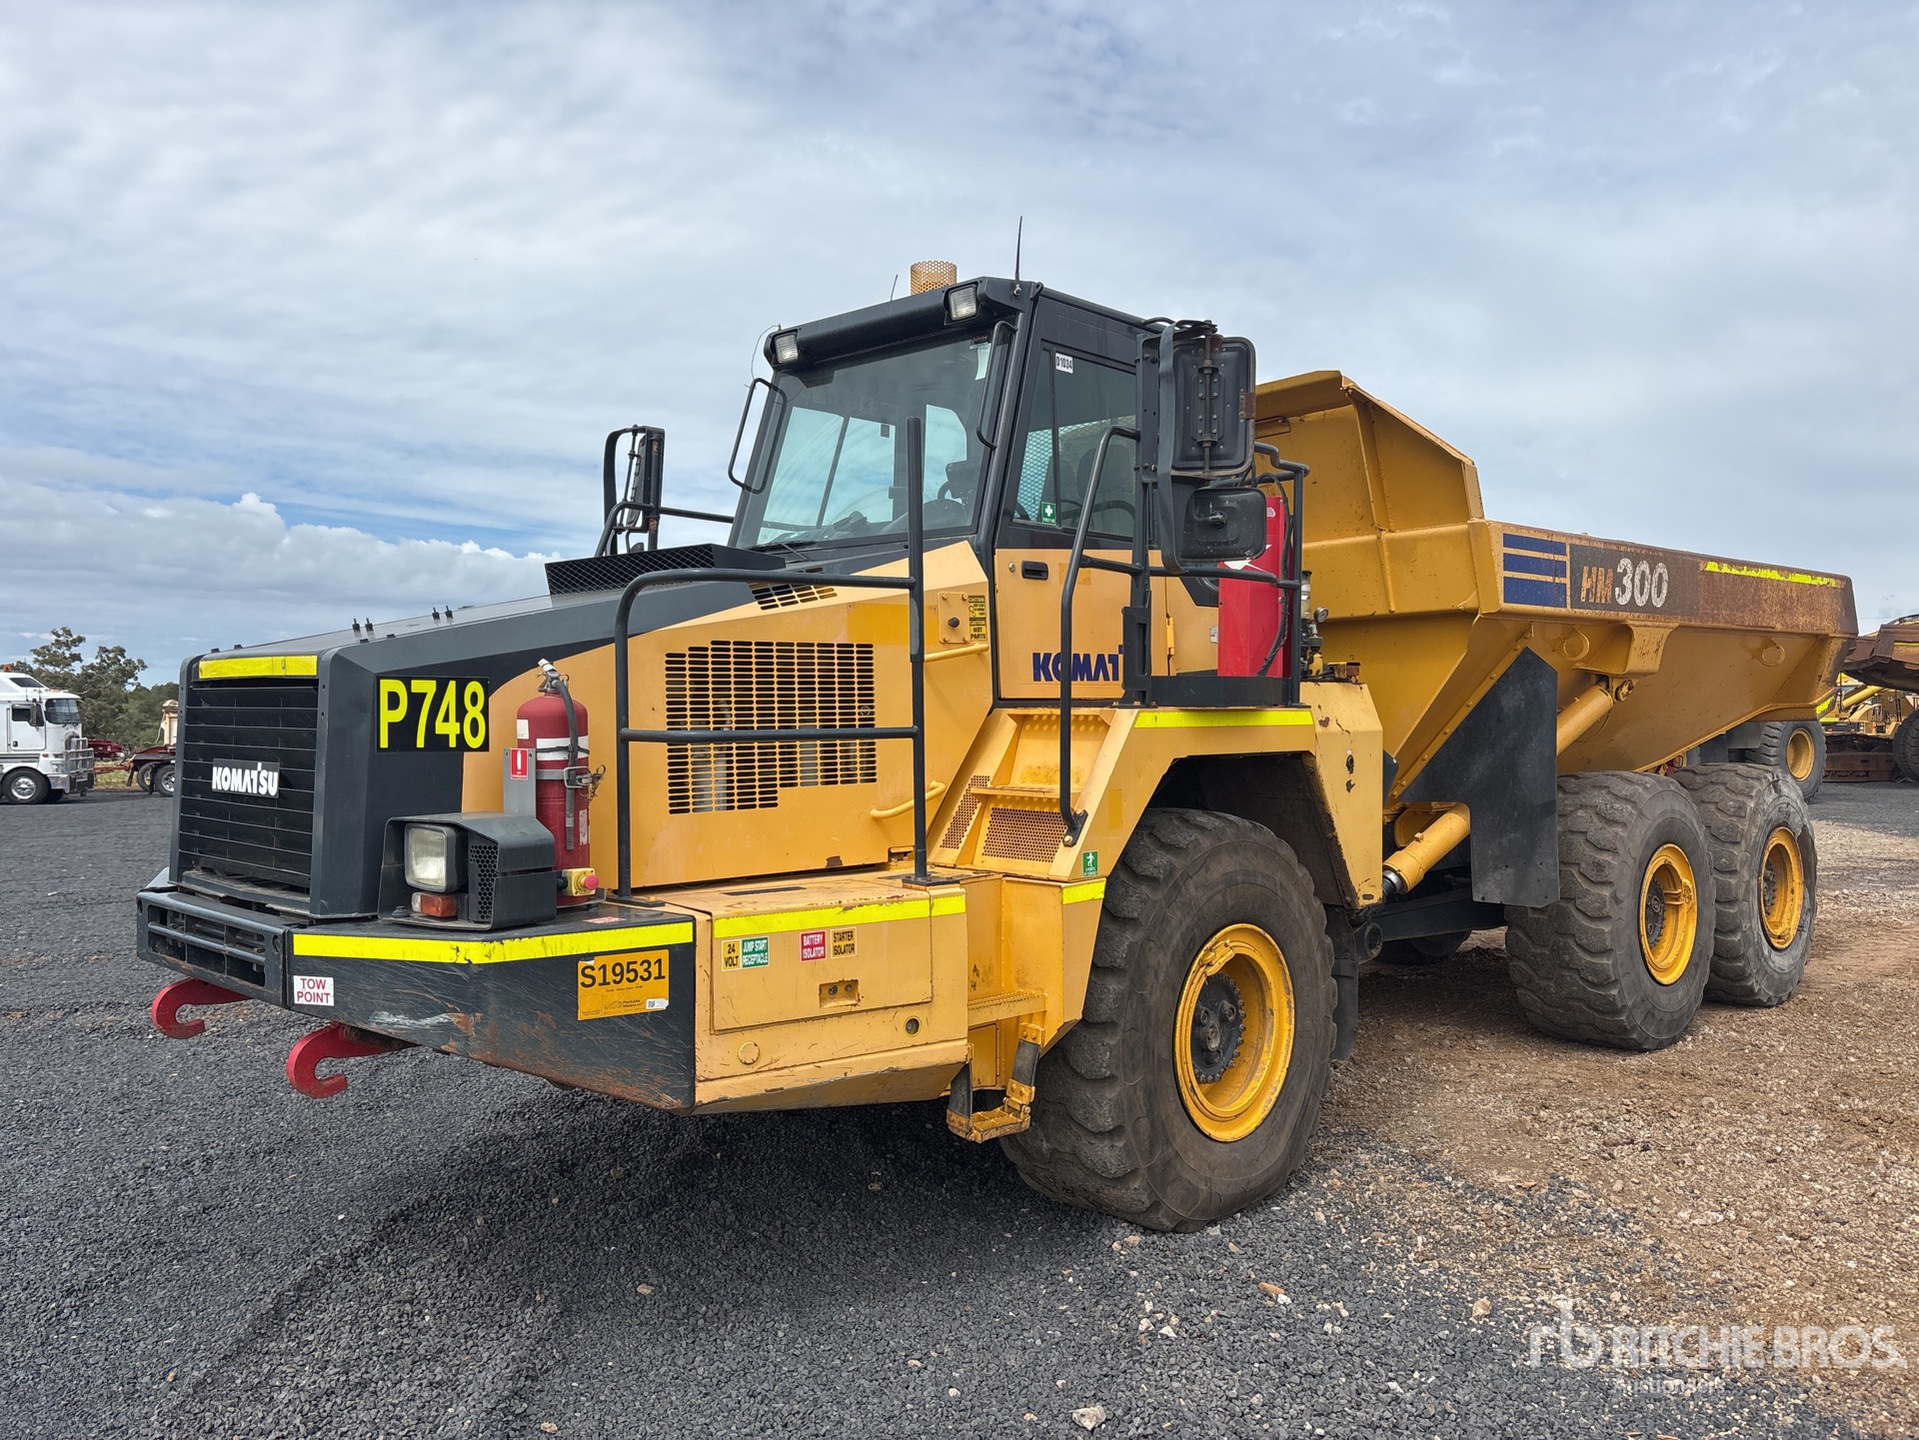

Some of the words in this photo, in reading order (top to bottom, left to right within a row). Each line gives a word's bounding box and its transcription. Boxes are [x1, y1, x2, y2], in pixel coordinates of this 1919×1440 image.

[1032, 645, 1124, 682] KMAT
[380, 679, 486, 749] P748
[212, 762, 279, 796] KOMATSU
[803, 934, 823, 946] BATTERY
[833, 931, 853, 942] STARTER
[727, 943, 736, 954] 24
[803, 947, 824, 959] ISOLATOR
[833, 943, 855, 956] ISOLATOR
[724, 955, 739, 968] VOLT
[580, 958, 666, 988] S19531
[300, 977, 327, 990] TOW
[297, 991, 331, 1004] POINT
